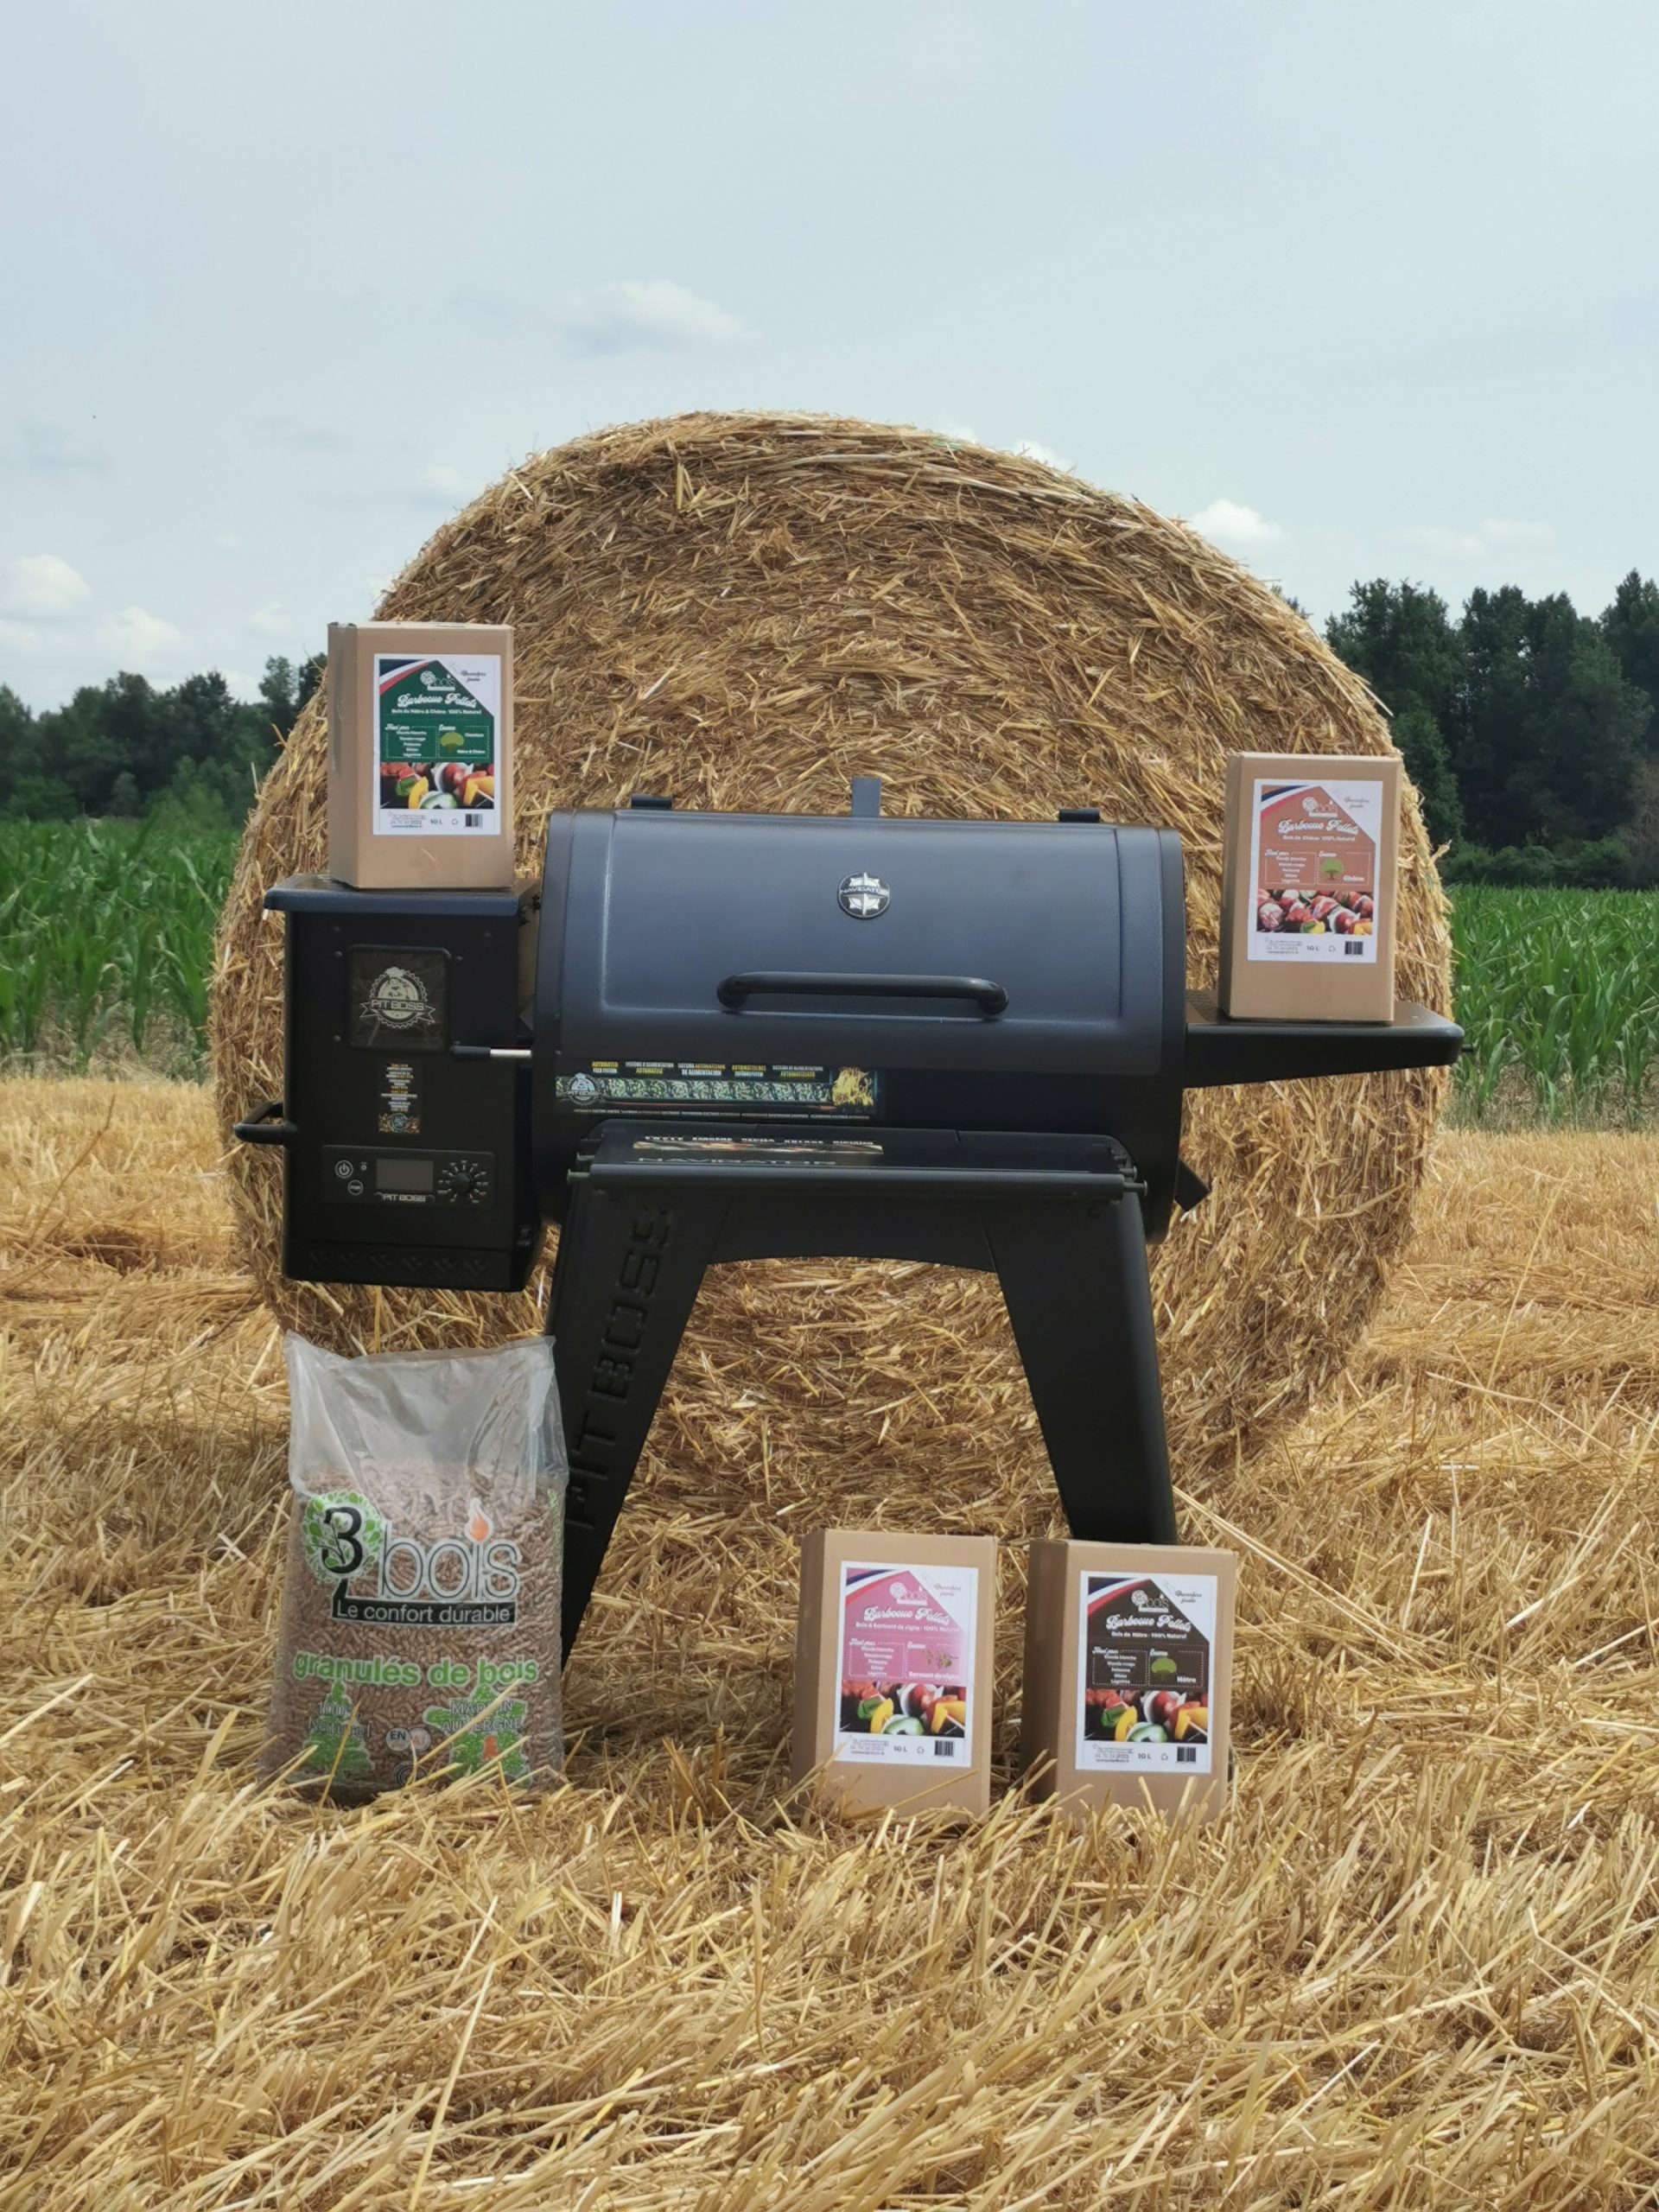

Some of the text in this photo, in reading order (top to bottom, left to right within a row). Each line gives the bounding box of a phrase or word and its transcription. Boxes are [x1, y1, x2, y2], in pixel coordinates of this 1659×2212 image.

[397, 693, 477, 708] Barbecue Pellets
[1277, 819, 1359, 836] Barbecue Pellets
[840, 886, 889, 896] NAVIGATOR
[371, 999, 424, 1011] PIT BOSS
[337, 1603, 510, 1624] Le confort durable
[864, 1606, 950, 1624] Barbecue Pellets
[1106, 1614, 1192, 1632] Barbecue Pellets
[293, 1651, 538, 1685] granulés de bois
[390, 1731, 406, 1739] EN
